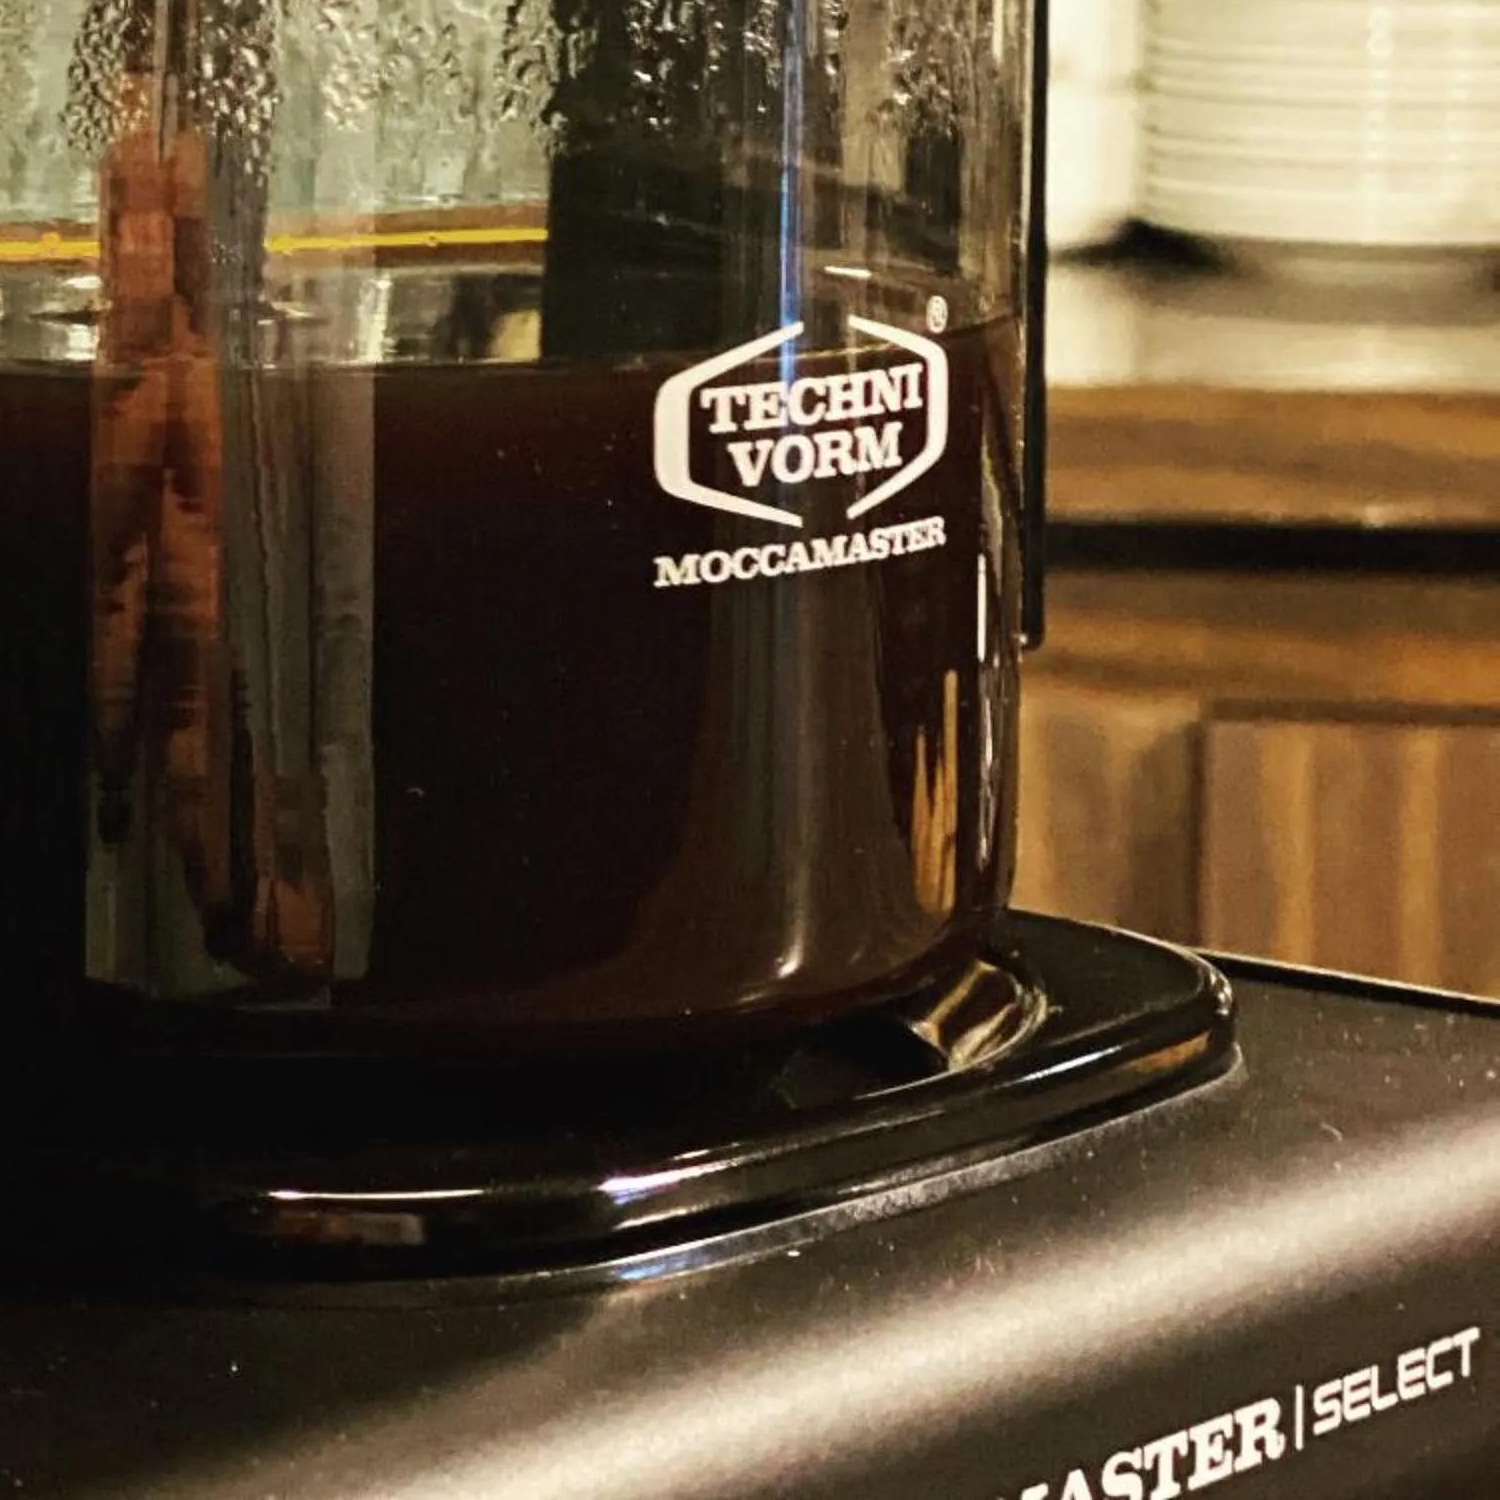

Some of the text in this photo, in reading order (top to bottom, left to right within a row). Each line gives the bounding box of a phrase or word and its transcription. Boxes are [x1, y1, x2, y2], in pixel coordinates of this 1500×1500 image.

[701, 363, 924, 434] TECHNI
[727, 421, 903, 487] VORM
[653, 515, 947, 588] MOCCAMASTER
[997, 1326, 1481, 1500] ASTER SELECT
